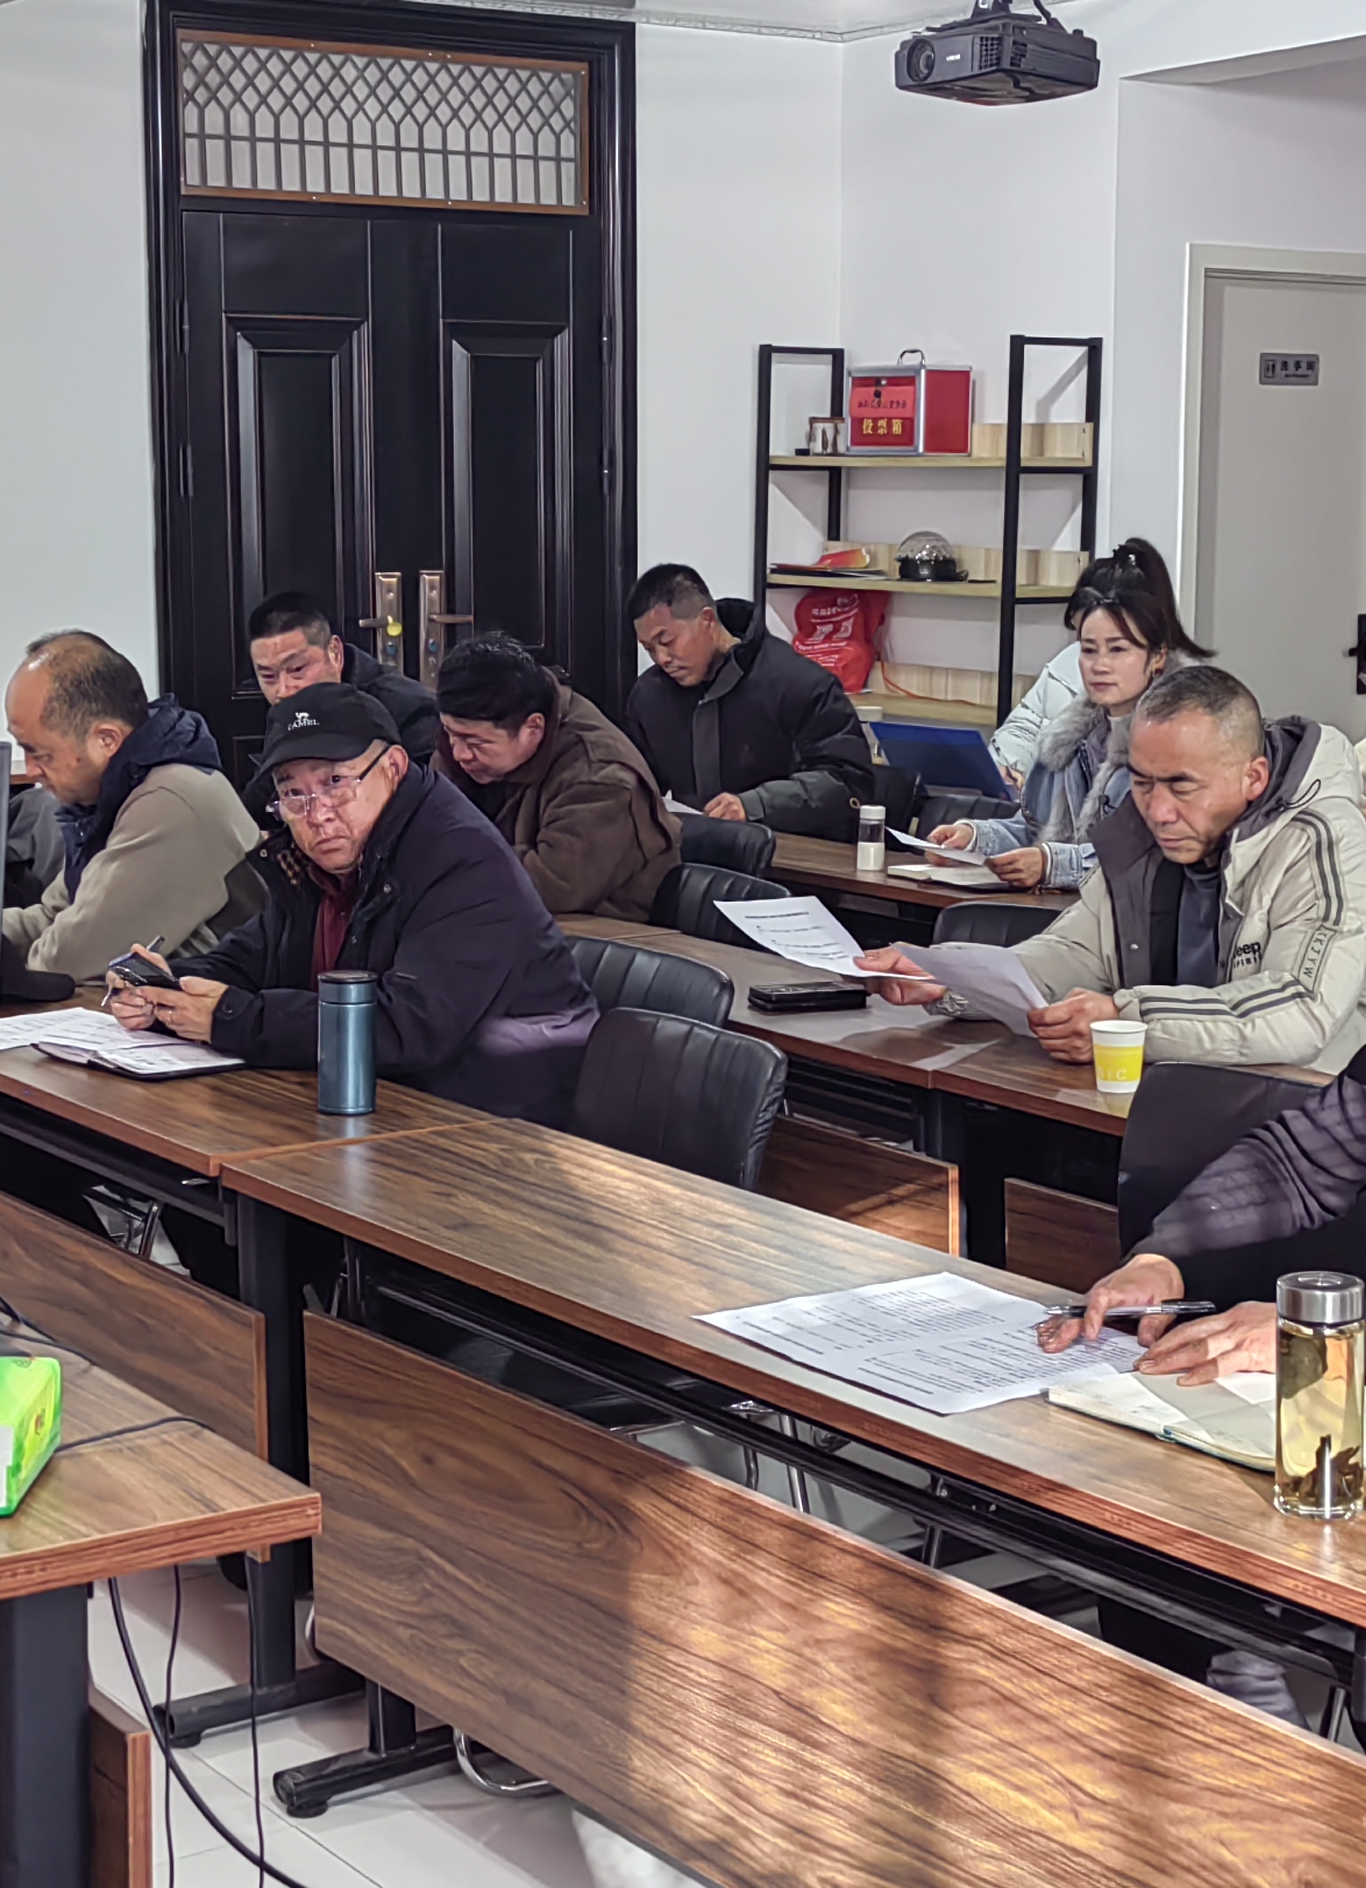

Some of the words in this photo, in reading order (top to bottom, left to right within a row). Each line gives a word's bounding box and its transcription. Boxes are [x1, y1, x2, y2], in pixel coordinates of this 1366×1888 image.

[862, 418, 903, 435] 投票箱
[287, 718, 318, 731] CAMEL
